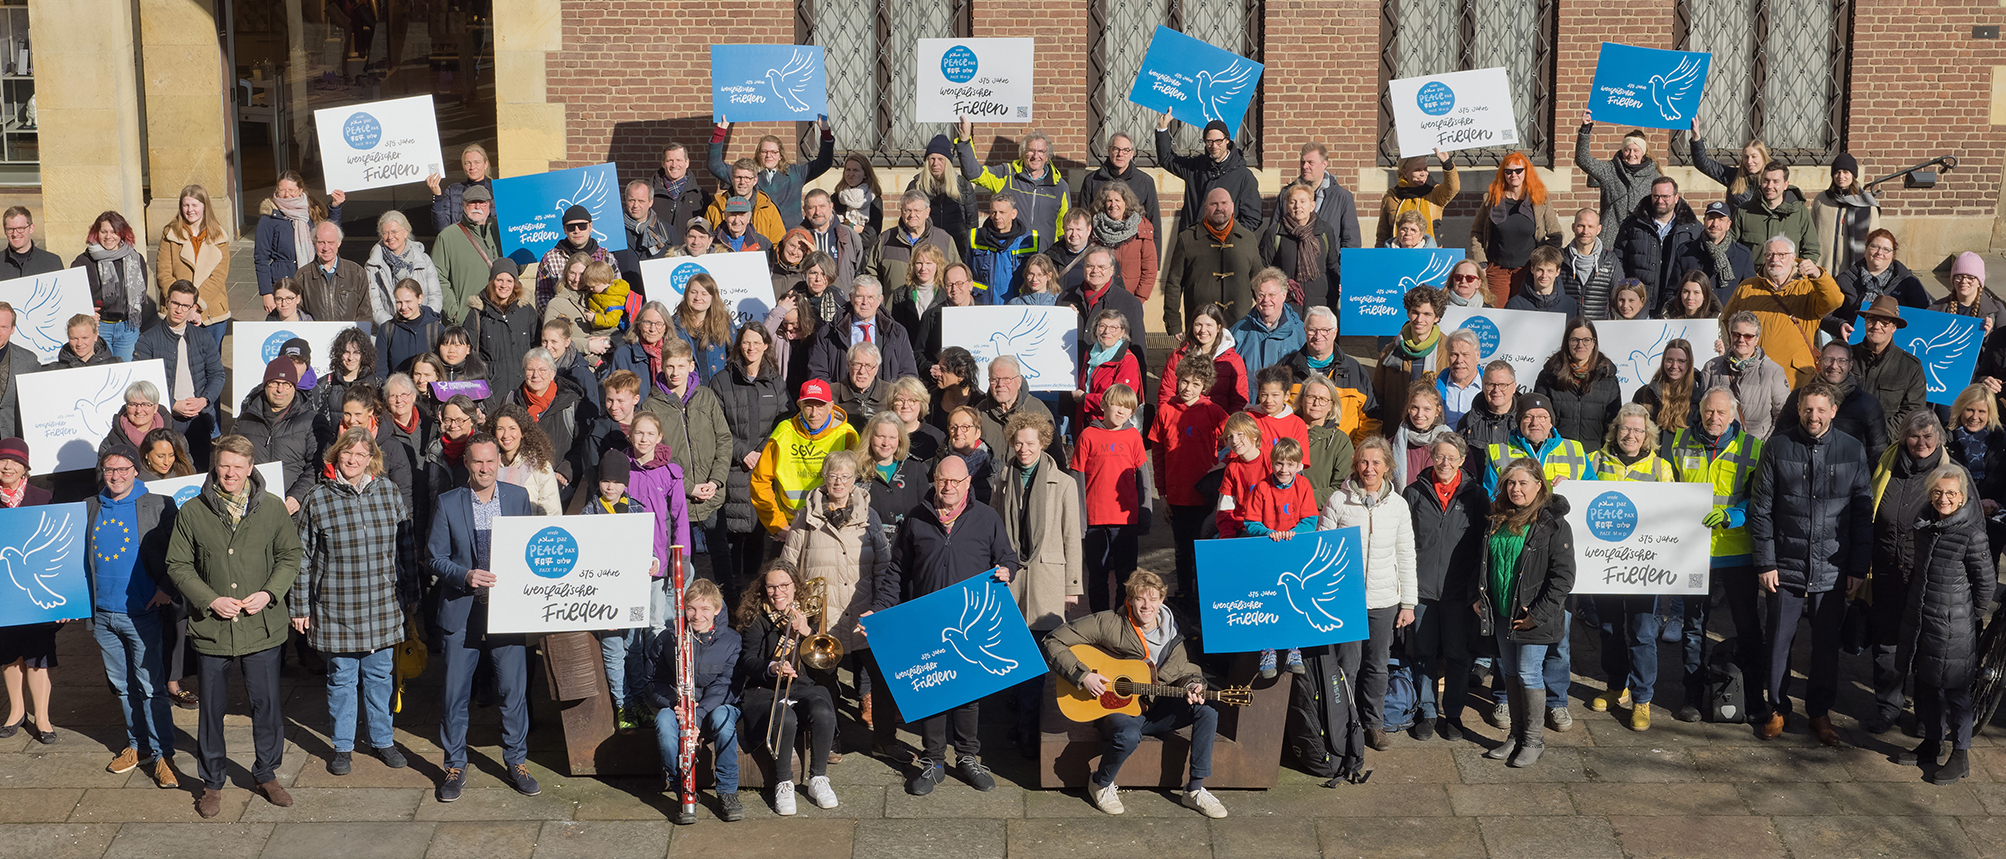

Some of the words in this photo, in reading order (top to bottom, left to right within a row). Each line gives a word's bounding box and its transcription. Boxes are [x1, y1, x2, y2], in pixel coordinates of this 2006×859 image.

[1152, 82, 1187, 101] Frieden
[730, 93, 766, 104] Frieden
[1607, 96, 1643, 108] Frieden
[953, 100, 1008, 116] Frieden
[1437, 128, 1493, 145] Frieden
[363, 163, 419, 181] Frieden
[520, 230, 558, 244] Frieden
[1359, 304, 1397, 316] Frieden
[1515, 355, 1535, 363] Jahre
[44, 428, 77, 438] Frieden
[791, 444, 815, 456] SGV
[1638, 535, 1653, 544] 375
[1656, 535, 1679, 543] Jahre
[579, 569, 594, 579] 375
[597, 569, 620, 578] Jahre
[1602, 564, 1677, 586] Frieden
[542, 600, 618, 622] Frieden
[1227, 611, 1279, 626] Frieden
[932, 648, 946, 656] Jahre
[911, 670, 957, 691] Frieden
